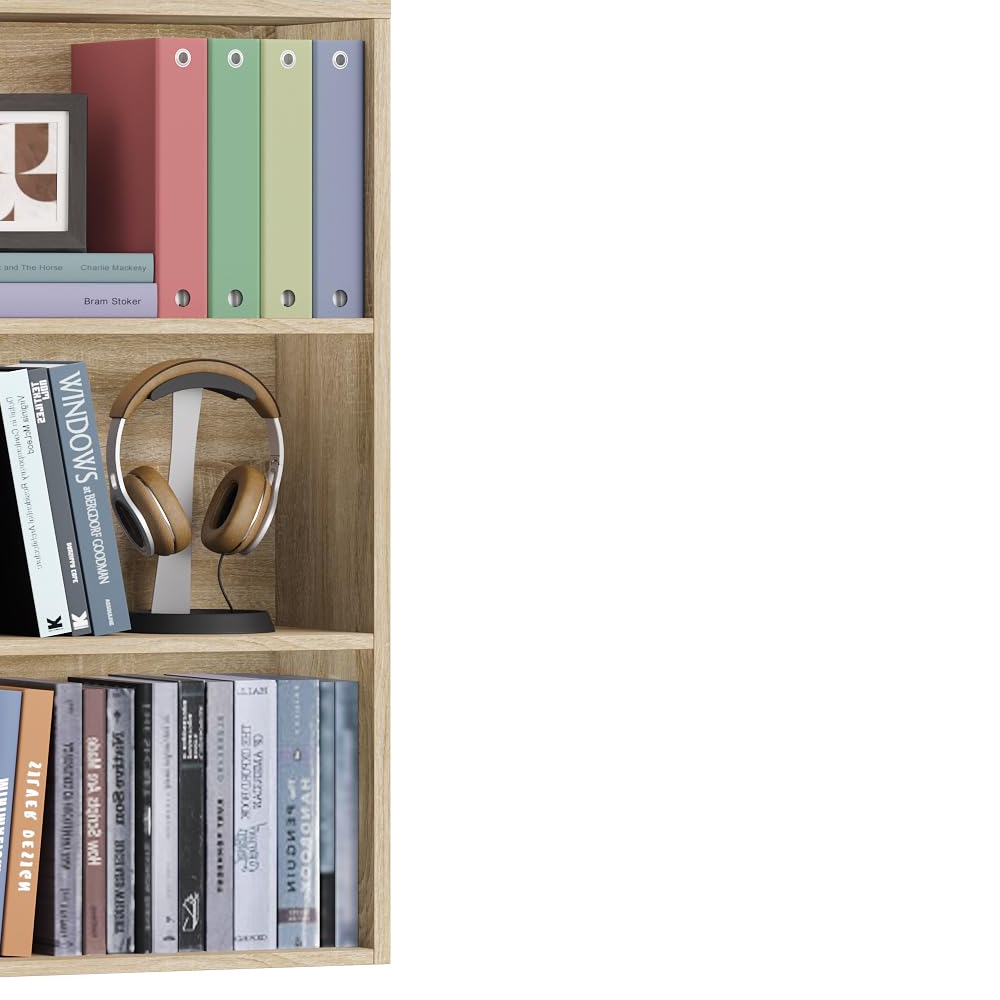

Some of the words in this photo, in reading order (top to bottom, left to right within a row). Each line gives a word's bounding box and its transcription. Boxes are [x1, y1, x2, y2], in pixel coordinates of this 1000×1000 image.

[56, 370, 98, 484] WINDOWS
[81, 485, 92, 494] at
[83, 493, 102, 538] BERGDORF
[90, 537, 110, 585] GOODMAN
